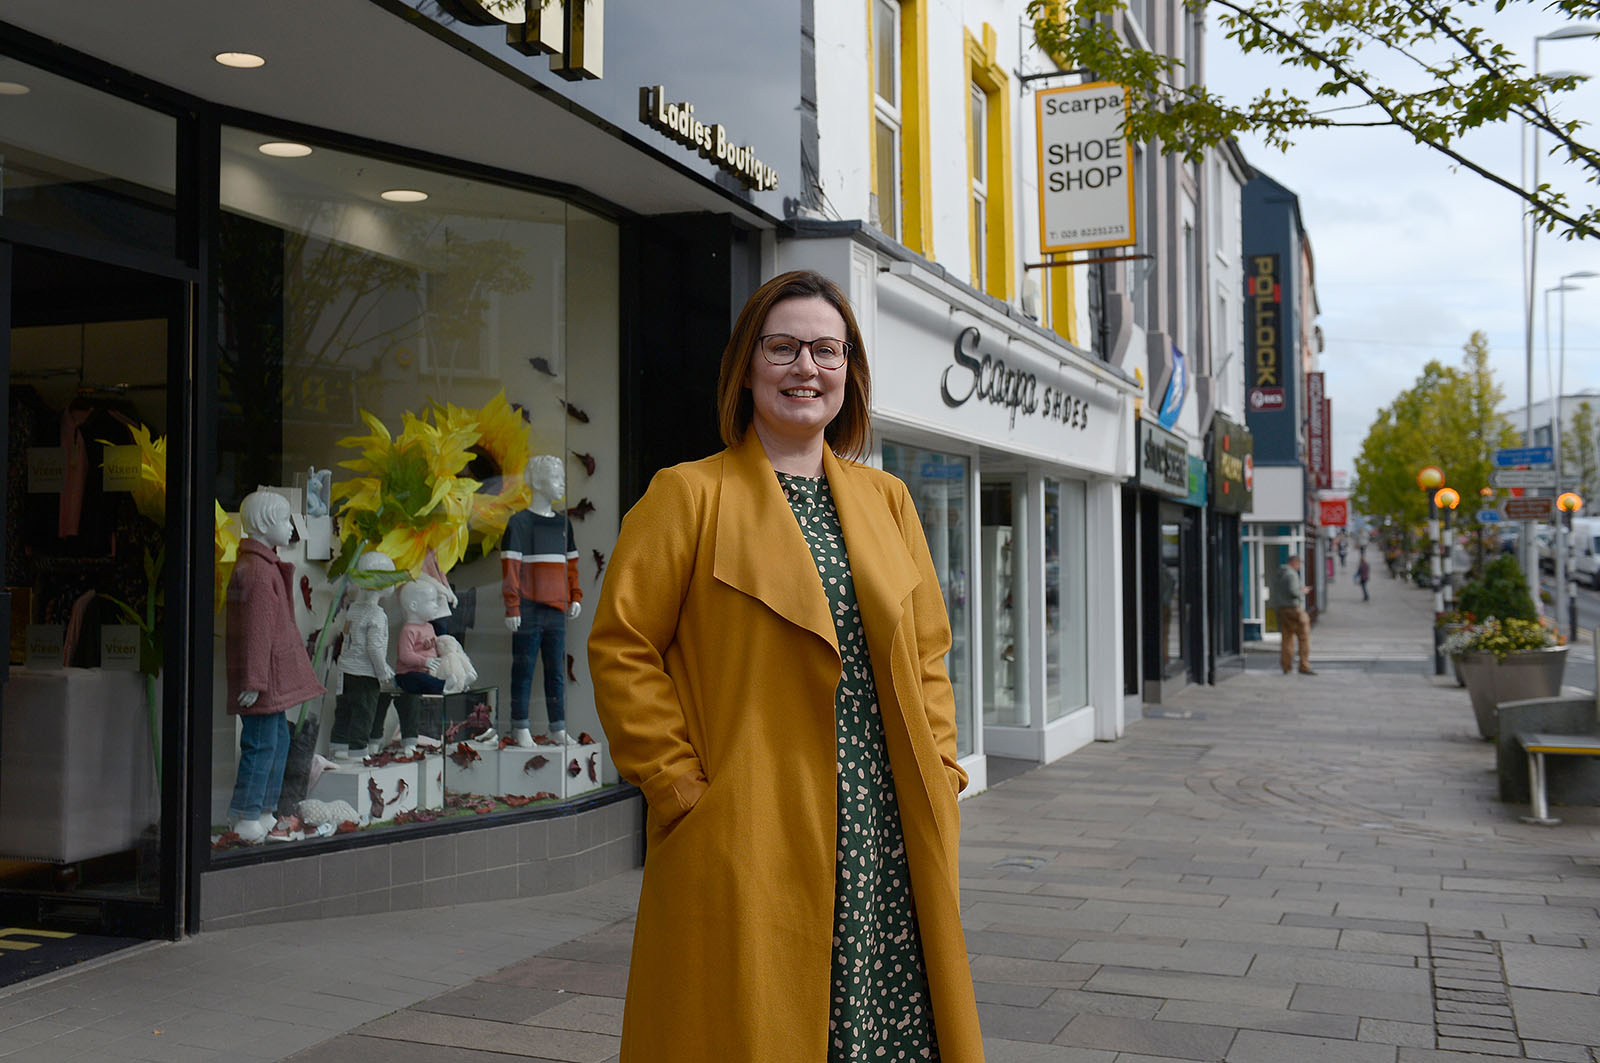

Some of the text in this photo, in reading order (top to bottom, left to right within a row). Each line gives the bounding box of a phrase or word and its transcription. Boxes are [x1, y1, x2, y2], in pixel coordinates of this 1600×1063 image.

[1046, 94, 1121, 115] Scarpa
[654, 85, 780, 191] Ladies Boutique
[1048, 138, 1122, 165] SHOE
[1049, 165, 1122, 192] SHOP
[1255, 256, 1277, 386] POLLOCK
[941, 326, 1039, 430] Scarpa
[1042, 387, 1089, 430] SHOES
[105, 642, 137, 654] Vixen
